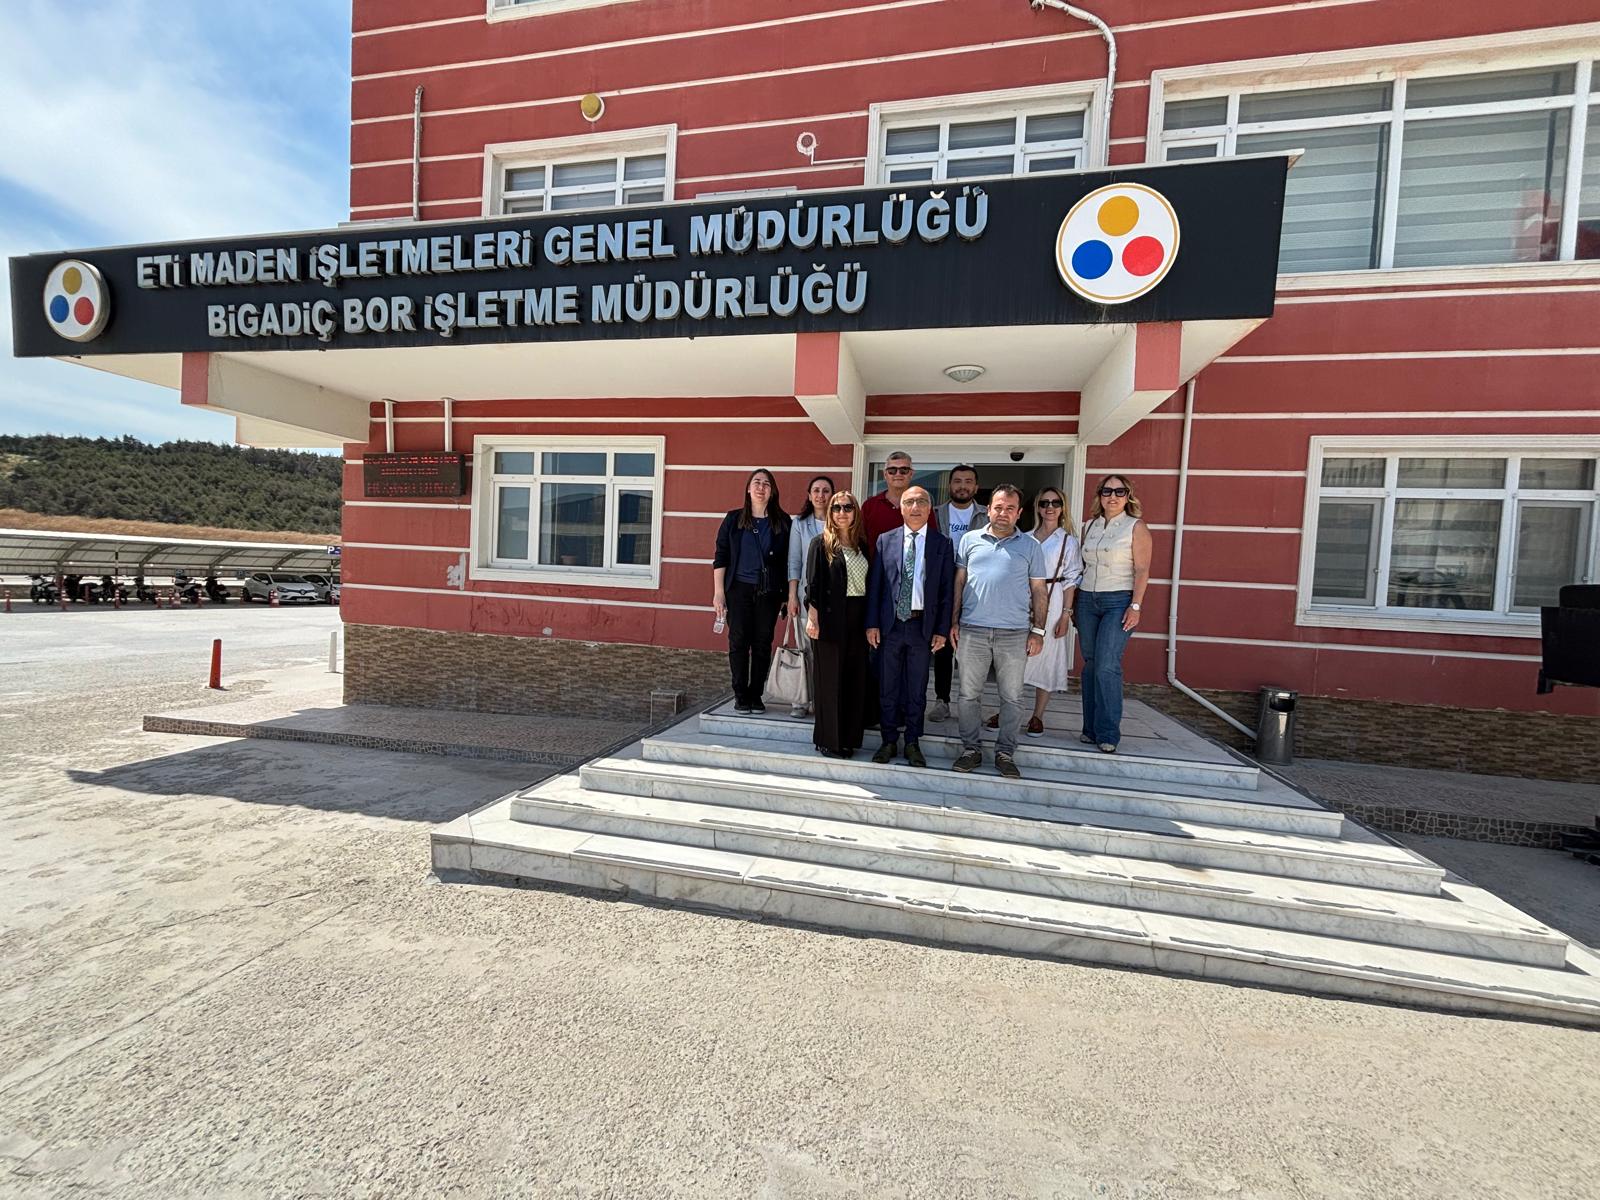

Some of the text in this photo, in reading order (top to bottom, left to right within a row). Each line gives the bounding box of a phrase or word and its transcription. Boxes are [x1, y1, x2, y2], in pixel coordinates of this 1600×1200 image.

[190, 250, 300, 287] MADEN
[543, 219, 677, 265] GENEL
[689, 186, 989, 256] MÜDÜRLÜĞÜ
[344, 295, 418, 333] BOR
[592, 262, 867, 325] MÜDÜRLÜĞÜ
